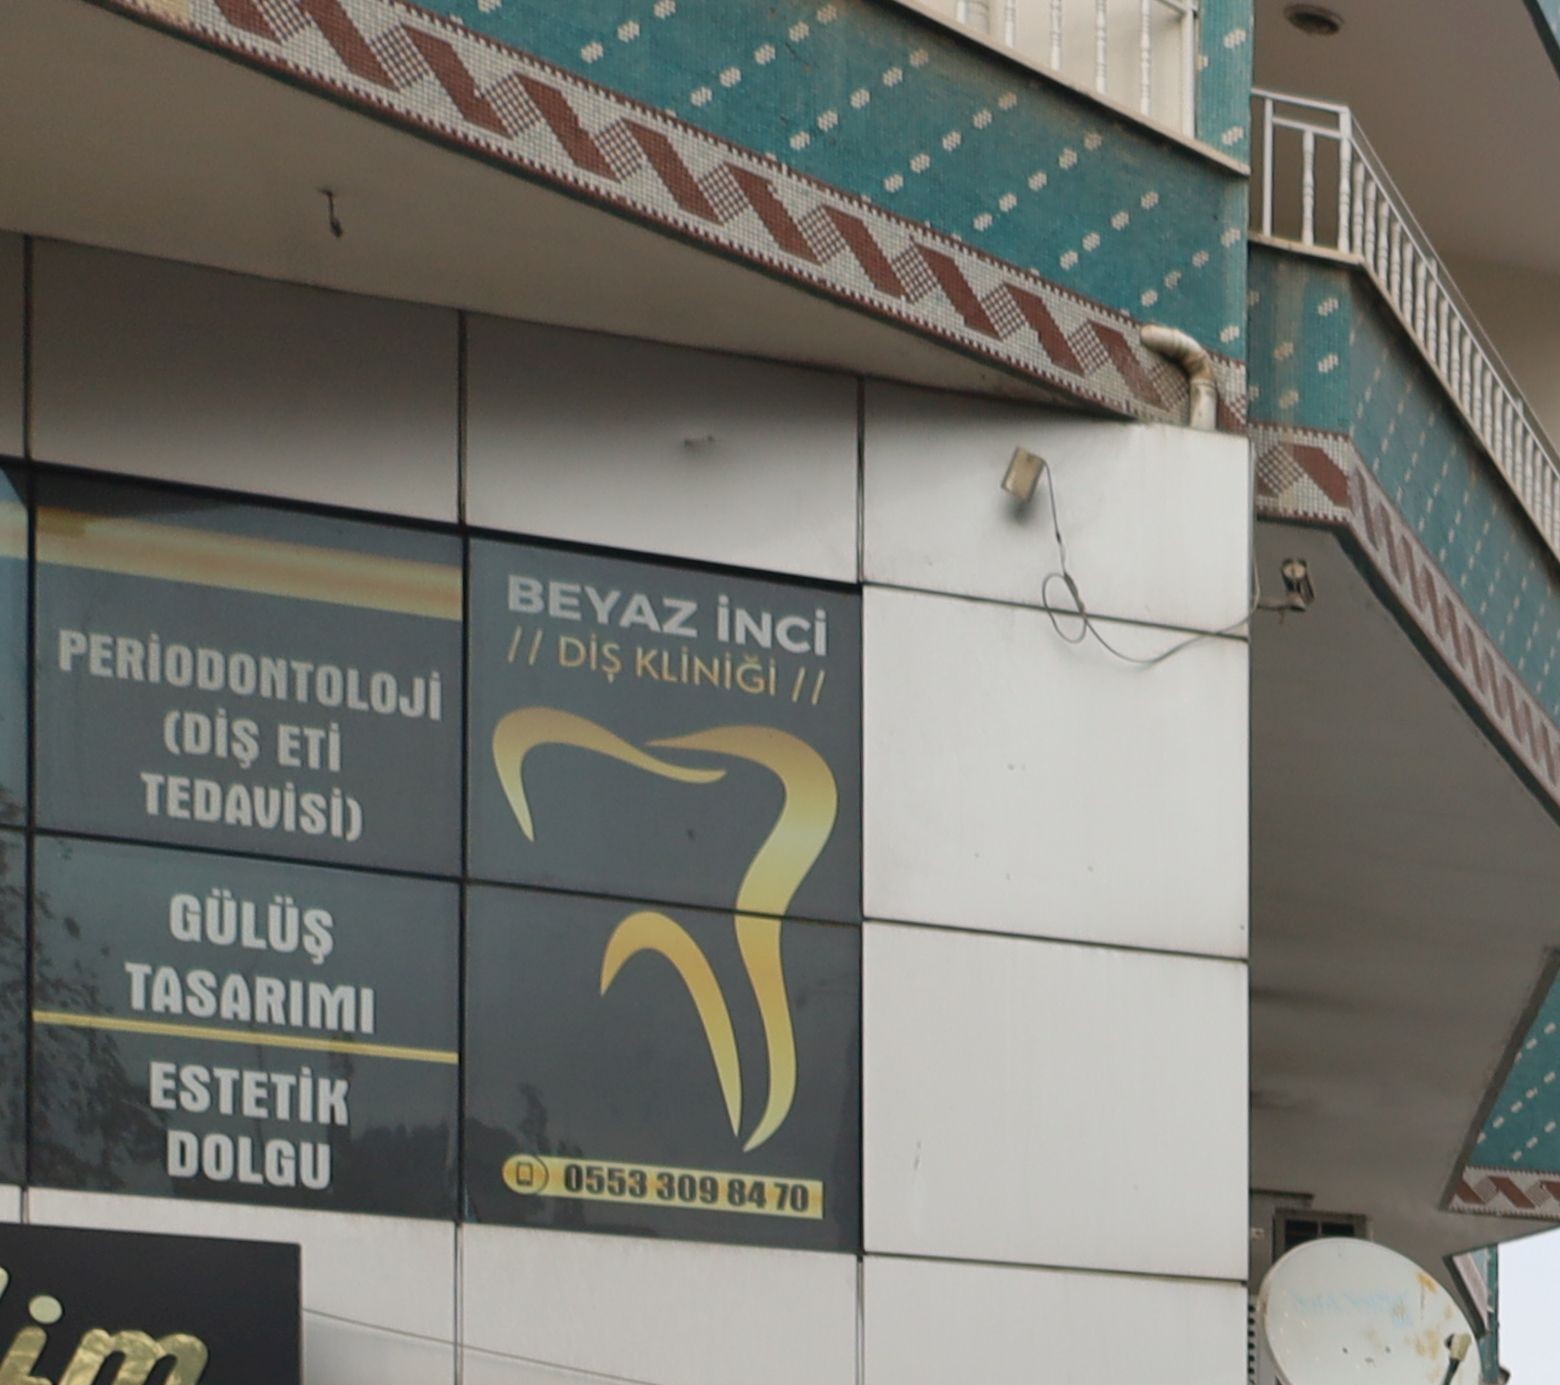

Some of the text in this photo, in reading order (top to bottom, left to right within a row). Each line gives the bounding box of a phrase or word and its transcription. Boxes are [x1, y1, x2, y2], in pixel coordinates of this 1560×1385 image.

[506, 574, 828, 657] BEYAZ İNCİ
[59, 628, 443, 722] PERİODONTOLOJİ
[559, 635, 778, 697] DİŞ KLİNİĞİ
[163, 711, 342, 772] (DİŞ ETİ
[140, 771, 363, 842] TEDAVİSİ)
[169, 890, 334, 966] GÜLÜŞ
[125, 961, 376, 1034] TASARIMI
[149, 1061, 350, 1126] ESTETİK
[167, 1131, 331, 1190] DOLGU
[564, 1163, 809, 1213] 0553 309 84 70
